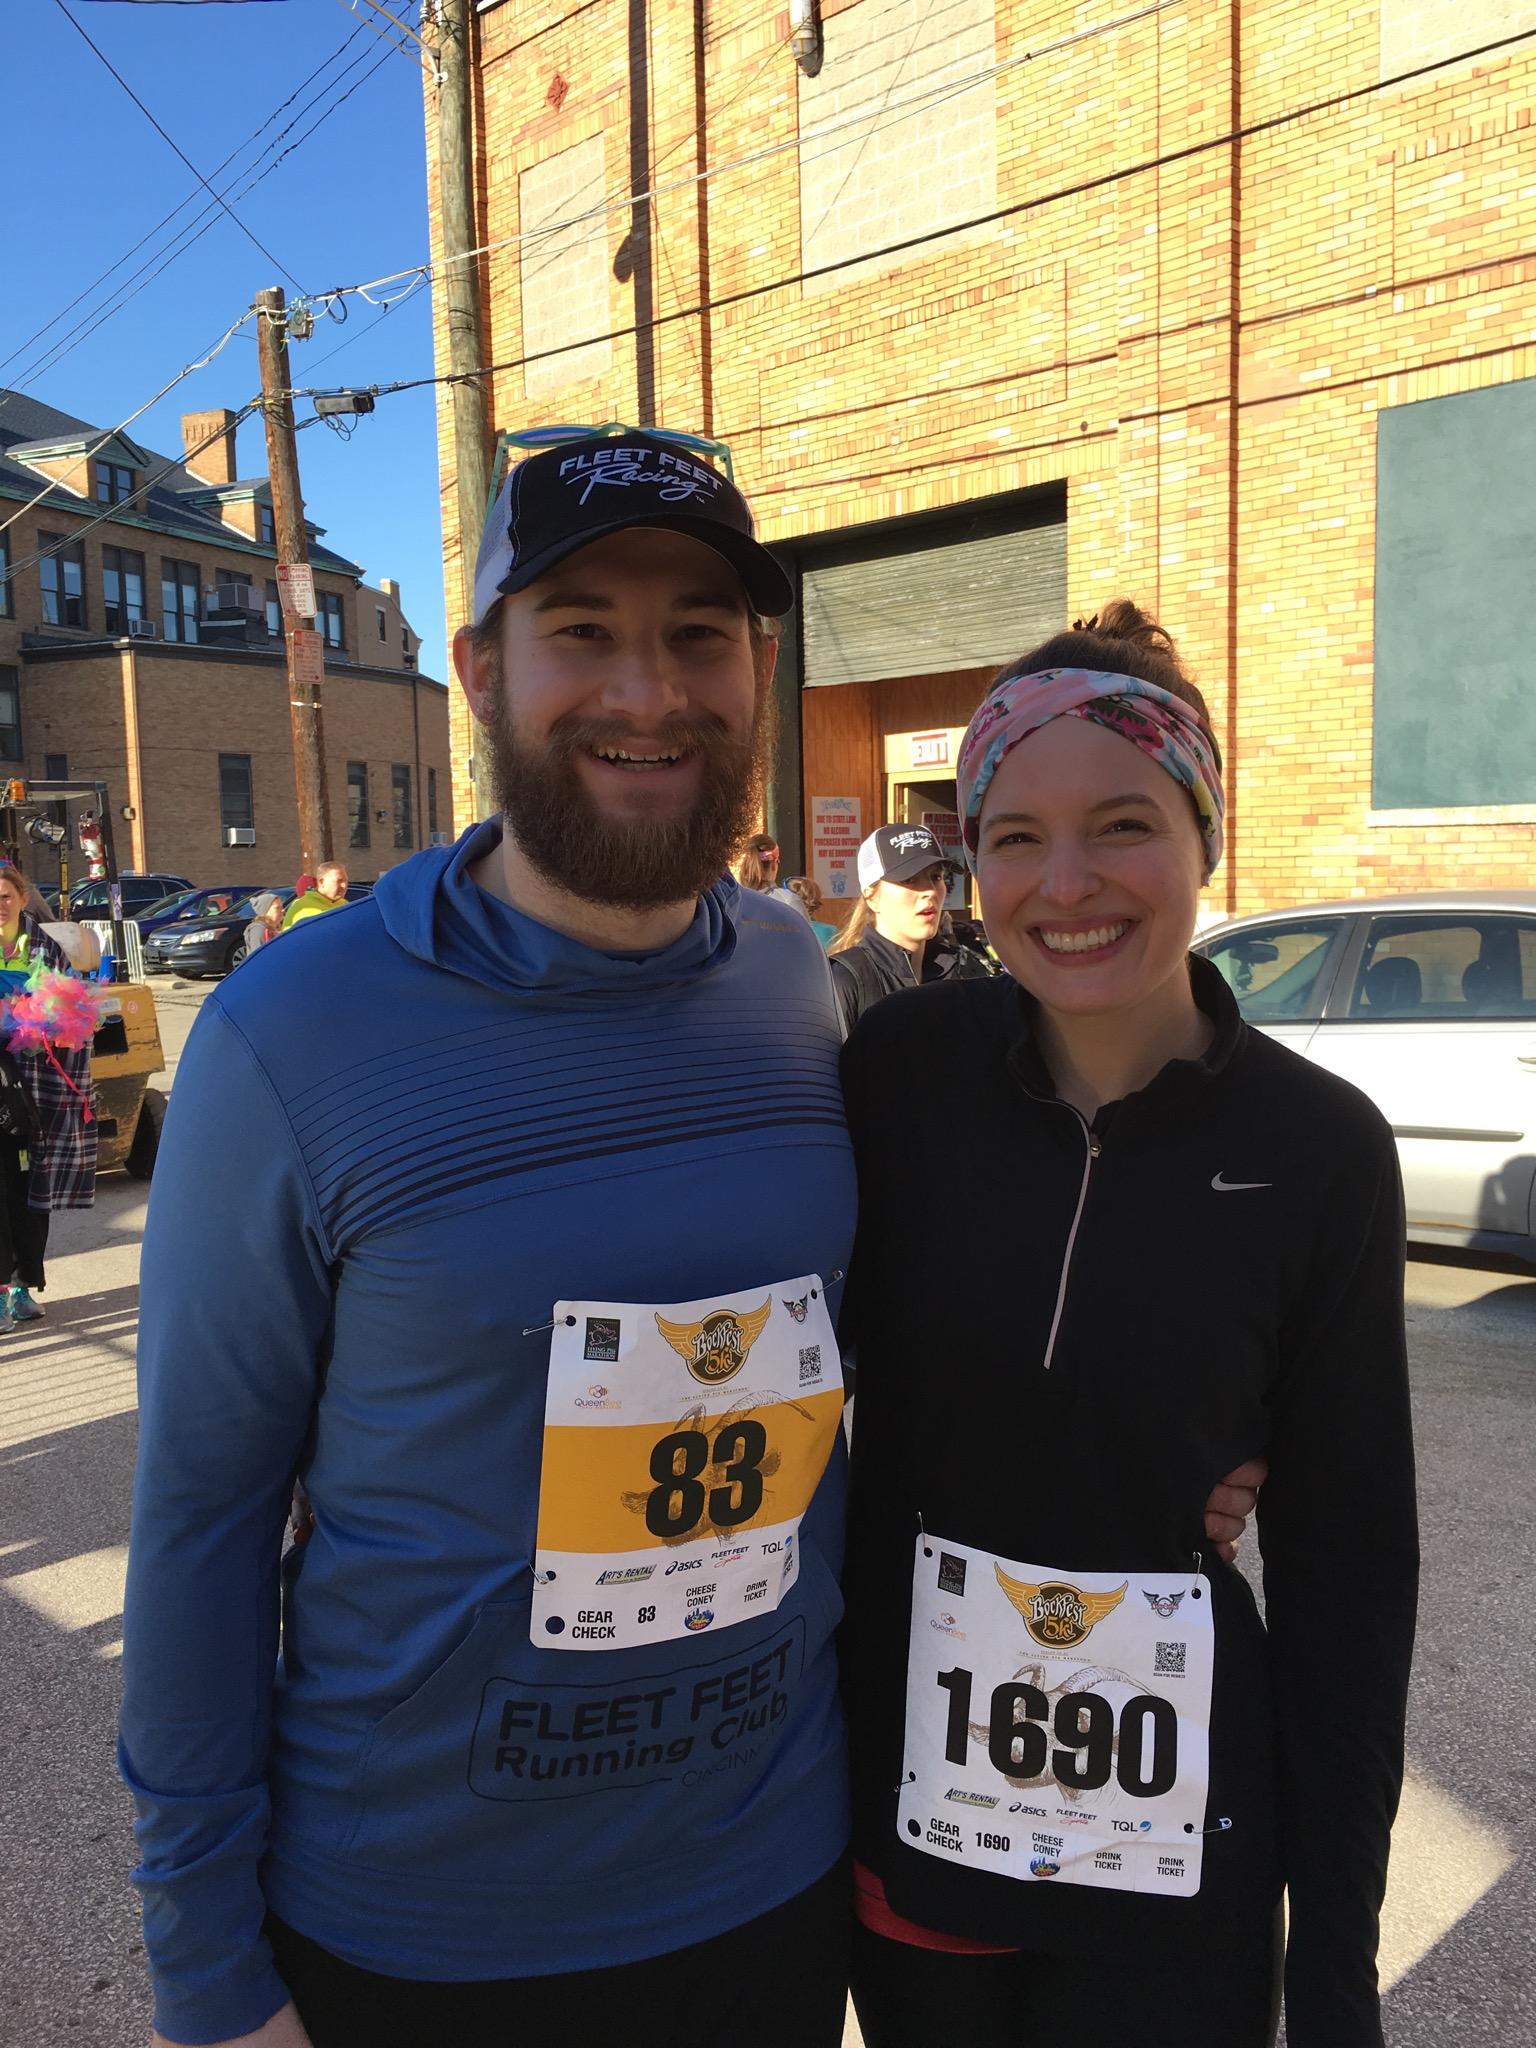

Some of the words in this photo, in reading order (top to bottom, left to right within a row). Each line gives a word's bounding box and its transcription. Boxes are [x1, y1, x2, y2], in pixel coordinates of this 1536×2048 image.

[559, 448, 653, 477] FLEET
[658, 452, 723, 490] FEET
[566, 462, 714, 505] Racing
[645, 1420, 768, 1538] 83
[711, 1548, 732, 1559] FLEET
[732, 1546, 750, 1555] FEET
[761, 1540, 784, 1556] TQL
[686, 1583, 717, 1598] CHEESE
[746, 1579, 768, 1593] DRINK
[687, 1594, 714, 1607] CONEY
[743, 1589, 768, 1603] TICKET
[577, 1610, 613, 1624] GEAR
[637, 1605, 656, 1624] 83
[571, 1626, 616, 1639] CHECK
[502, 1687, 676, 1741] FLEET
[690, 1638, 794, 1722] FEET
[493, 1734, 694, 1782] Running
[711, 1690, 788, 1750] Club
[937, 1666, 1178, 1798] 1690
[1056, 1808, 1078, 1818] FLEET
[1079, 1812, 1097, 1821] FEET
[930, 1817, 960, 1837] GEAR
[1111, 1820, 1138, 1833] TQL
[926, 1832, 963, 1853] CHECK
[975, 1832, 1011, 1852] 1690
[1032, 1831, 1064, 1848] CHEESE
[1033, 1842, 1062, 1859] CONEY
[1096, 1852, 1122, 1862] DRINK
[1094, 1859, 1122, 1872] TICKET
[1159, 1857, 1185, 1867] DRINK
[1156, 1865, 1185, 1877] TICKET
